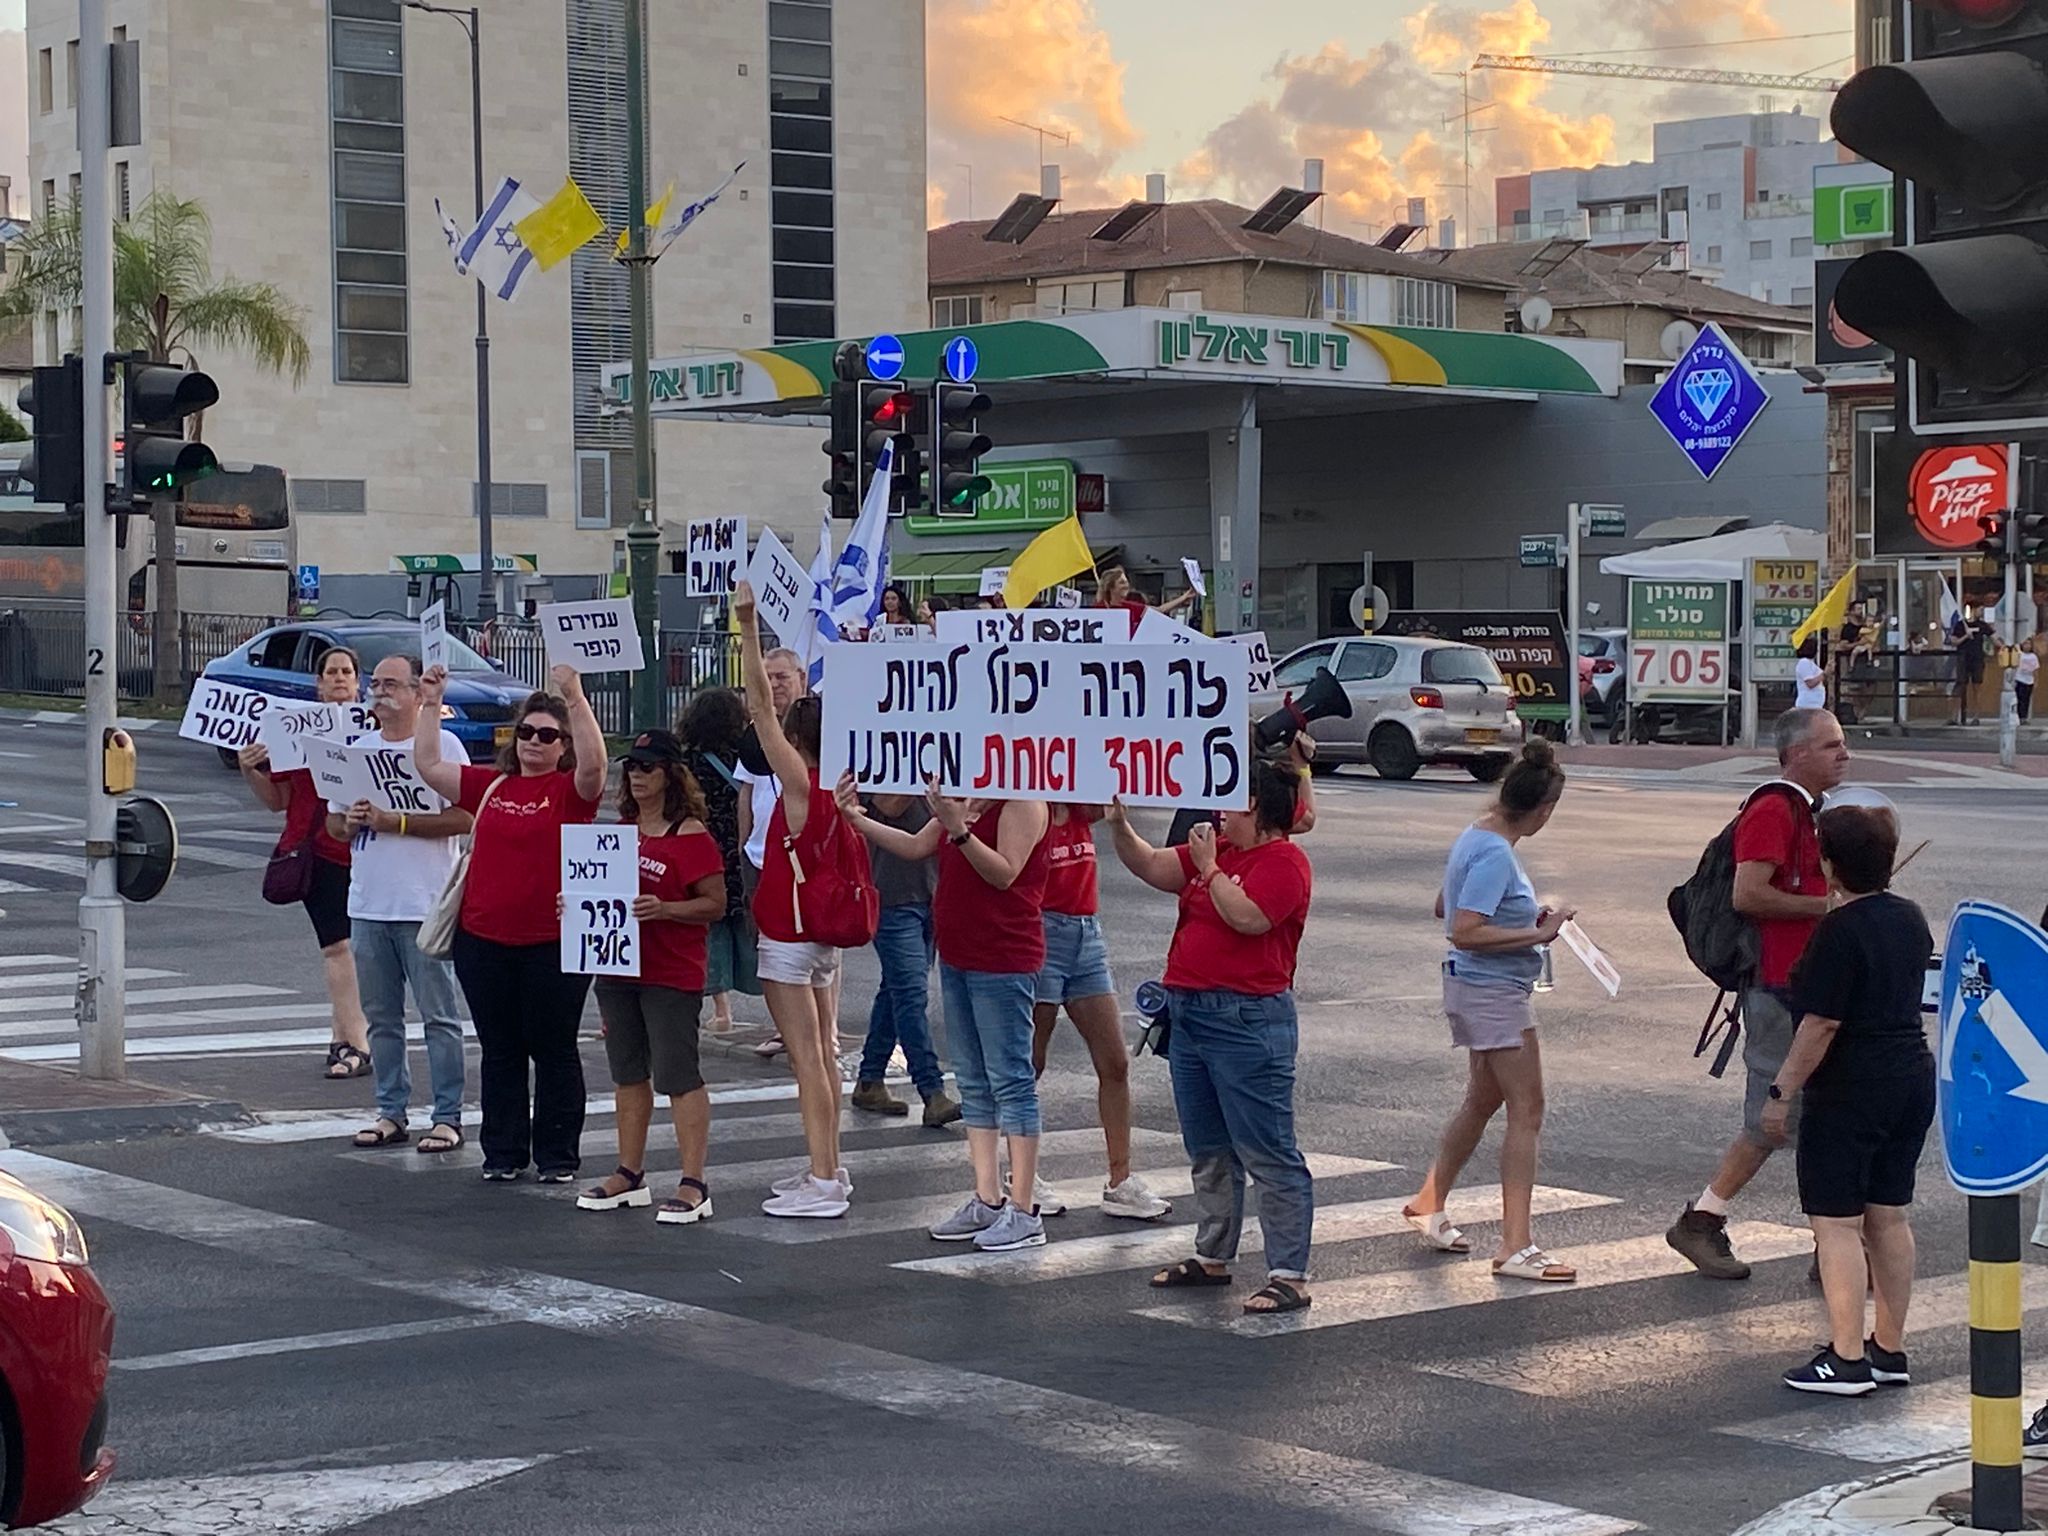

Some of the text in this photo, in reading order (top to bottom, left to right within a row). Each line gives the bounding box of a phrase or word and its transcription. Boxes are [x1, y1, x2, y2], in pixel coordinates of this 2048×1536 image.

[1160, 315, 1350, 368] דור אלון
[689, 361, 739, 398] דור
[1037, 479, 1060, 492] מיני
[1929, 480, 1994, 513] Pizza
[1032, 496, 1060, 510] סופר
[1939, 498, 1991, 529] Hut
[491, 556, 514, 569] סול
[770, 553, 800, 599] ענבר
[1763, 563, 1806, 580] סולר
[761, 582, 790, 623] הימן
[1645, 585, 1715, 605] מחירון
[558, 612, 619, 632] עמירם
[1654, 605, 1705, 624] סולר
[88, 648, 104, 675] 2
[573, 638, 621, 658] קופר
[1521, 647, 1553, 665] קפה
[877, 642, 971, 714] להיות
[986, 642, 1050, 715] יכול
[1633, 648, 1721, 685] 7.05
[1079, 659, 1147, 719] היה
[1167, 657, 1228, 719] זה
[204, 688, 268, 721] שלמה
[195, 711, 261, 747] מנסור
[280, 706, 334, 735] נעמה
[364, 748, 413, 790] אלון
[848, 725, 1240, 798] כל אחד ואחת מאיתנו
[596, 833, 620, 851] גיא
[568, 858, 608, 880] דלאל
[580, 898, 628, 929] הדר
[579, 928, 632, 972] גולדין
[1814, 1362, 1836, 1380] N
